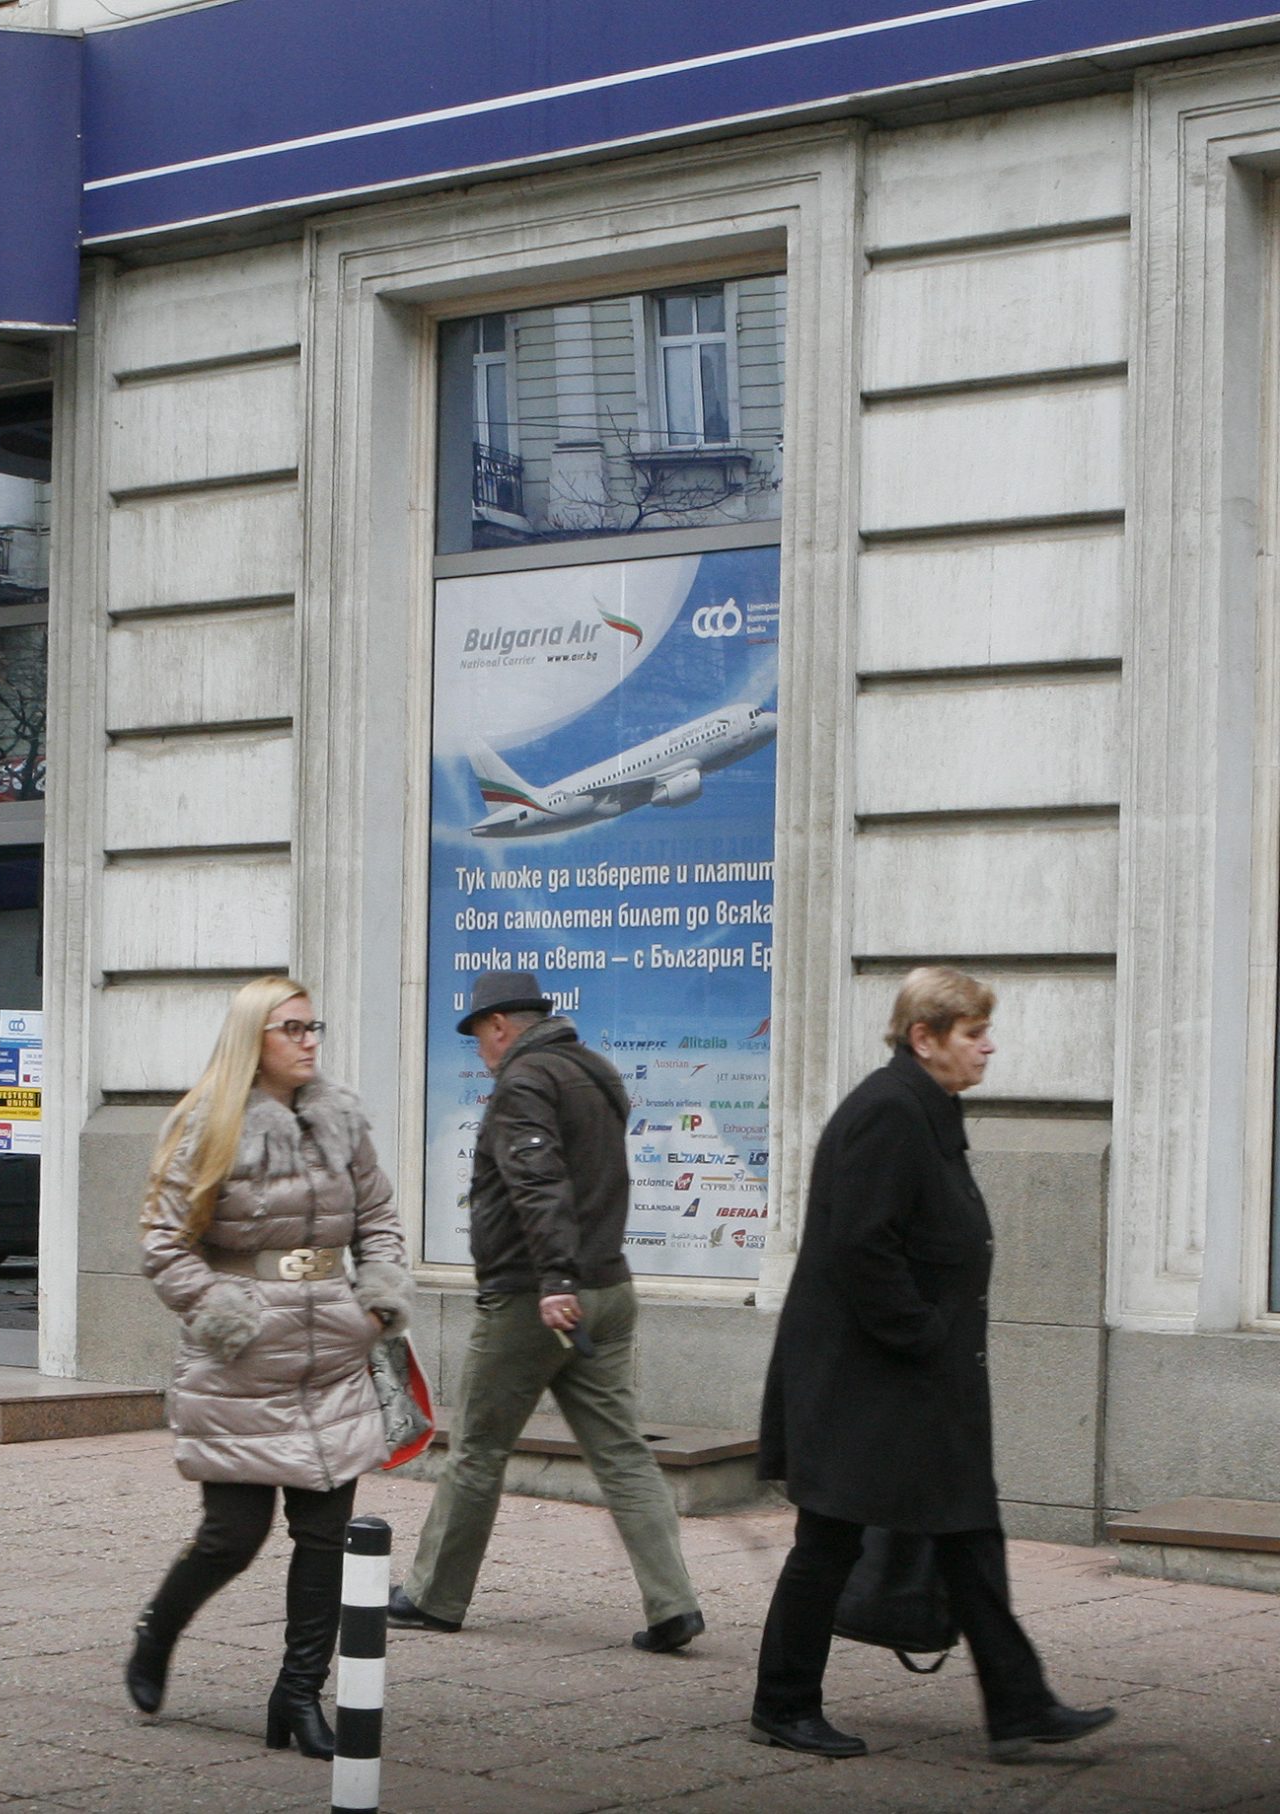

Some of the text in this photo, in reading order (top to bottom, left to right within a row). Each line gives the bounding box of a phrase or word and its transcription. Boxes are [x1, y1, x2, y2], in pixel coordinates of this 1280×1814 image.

[463, 620, 601, 655] Bulgaria Air
[546, 650, 598, 663] www.air.bg
[460, 655, 535, 670] National Carrier
[455, 861, 775, 895] Тук може да изберете и платит
[455, 900, 773, 931] своя самолетен билет до всяка
[455, 947, 511, 970] точка
[518, 951, 538, 970] на
[545, 946, 606, 970] света
[634, 949, 644, 969] с
[651, 944, 744, 973] България
[454, 992, 464, 1011] и
[614, 1040, 668, 1048] OLYMPIC
[678, 1035, 728, 1049] Alitalia
[655, 1059, 689, 1069] Austrian
[717, 1073, 767, 1083] JET AIRWAYS
[6, 1099, 34, 1107] UNION
[710, 1100, 755, 1110] EVA AIR
[634, 1153, 662, 1163] KLM
[637, 1178, 674, 1188] atlantic
[700, 1183, 768, 1193] CYPRUS AIRWA
[634, 1203, 680, 1211] ICELANDAIR
[716, 1207, 759, 1218] IBERIA
[636, 1238, 666, 1246] AIRWAYS
